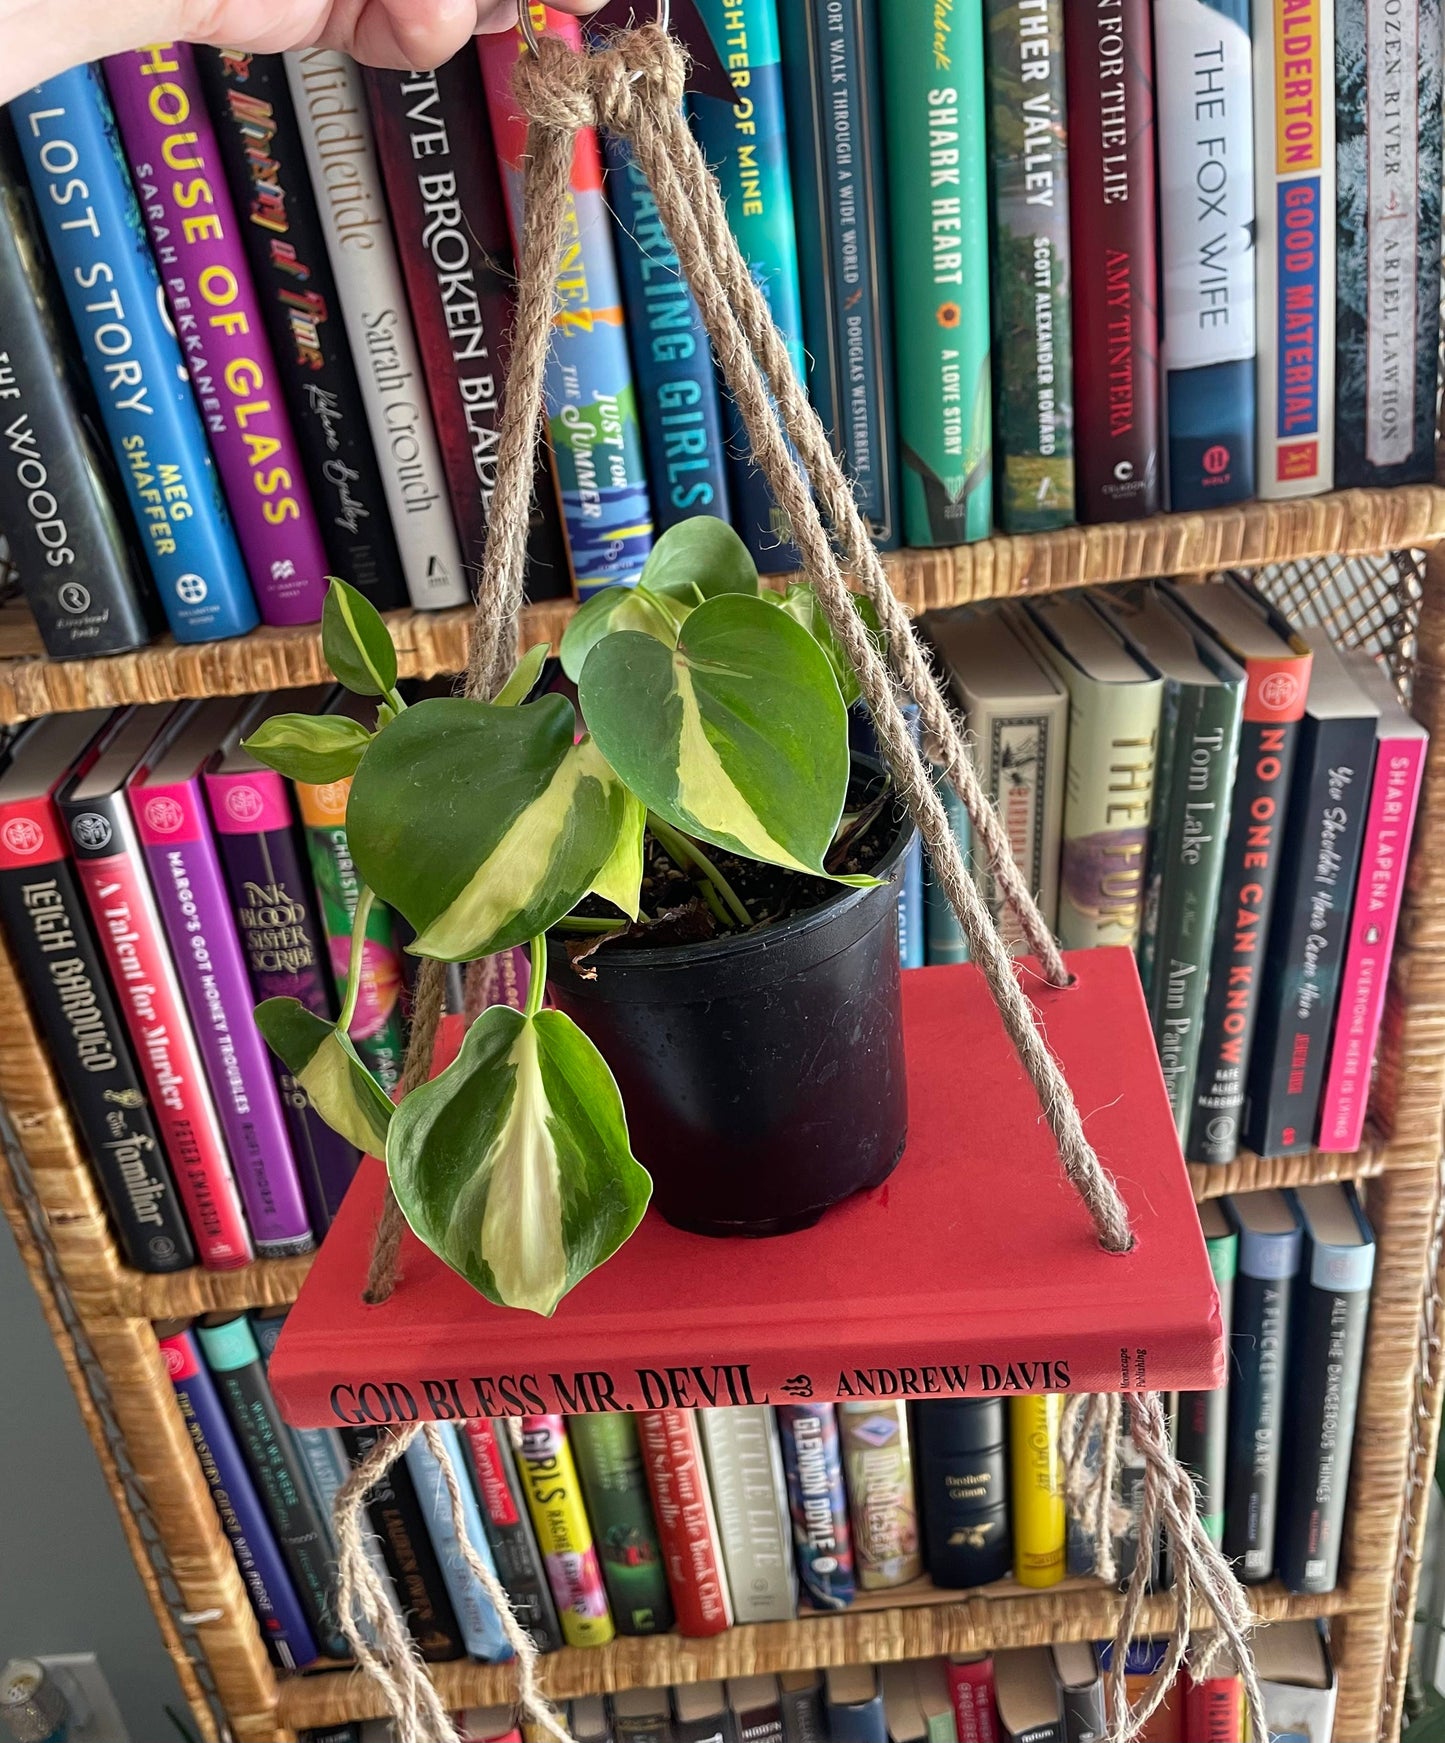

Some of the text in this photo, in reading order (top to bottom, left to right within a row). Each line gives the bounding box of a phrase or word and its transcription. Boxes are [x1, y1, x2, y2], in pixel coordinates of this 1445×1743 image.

[830, 38, 847, 84] WALK
[300, 47, 383, 250] Middletide
[733, 97, 756, 136] OF
[832, 88, 852, 165] THROUGH
[1023, 93, 1053, 208] VALLEY
[1098, 16, 1128, 205] FOR THE LIE
[1384, 91, 1400, 175] RIVER
[737, 144, 763, 217] MINE
[837, 170, 852, 181] A
[839, 184, 856, 226] WIDE
[927, 87, 963, 286] SHARK HEART
[1194, 40, 1229, 329] THE FOX WIFE
[29, 108, 153, 416] LOST STORY
[418, 170, 488, 362] BROKEN
[841, 231, 859, 284] WORLD
[1285, 186, 1314, 273] GOOD
[134, 43, 224, 244] HOUSE
[198, 265, 249, 336] OF
[224, 358, 300, 526] GLASS
[135, 163, 227, 434] SARAH PEKKANEN
[361, 309, 408, 393] Sarah
[562, 364, 582, 399] THE
[846, 316, 865, 383] DOUGLAS
[1034, 236, 1055, 456] SCOTT ALEXANDER HOWARD
[1105, 250, 1133, 437] AMY TINTERA
[1284, 283, 1314, 432] MATERIAL
[1382, 238, 1400, 441] ARIEL LAWHON
[592, 389, 628, 489] JUST FOR
[658, 379, 714, 509] GIRLS
[941, 349, 963, 456] A LOVE STORY
[5, 414, 75, 567] WOODS
[122, 434, 176, 556] SHAFFER
[158, 463, 193, 521] MEG
[383, 401, 441, 514] Crouch
[560, 404, 602, 519] SUMMER
[1106, 728, 1157, 824] THE
[1188, 726, 1224, 792] Tom
[1328, 766, 1354, 801] You
[1181, 802, 1215, 866] Lake
[1367, 756, 1410, 912] SHARI LAPENA
[1220, 729, 1286, 1064] NO ONE CAN KNOW
[22, 878, 117, 1073] LEIGH BARDUGO
[96, 879, 184, 1111] A Talent for Murder
[167, 851, 250, 1115] MARGO'S GOT MONEY TROUBLES
[1166, 958, 1197, 1010] Ann
[1351, 958, 1375, 1035] EVERYONE
[1344, 1039, 1360, 1075] HERE
[1333, 1097, 1353, 1140] LYING
[1327, 1328, 1346, 1358] THE
[1331, 1297, 1347, 1327] ALL
[330, 1364, 769, 1424] GOD BLESS MR. DEVIL
[835, 1360, 1072, 1397] ANDREW DAVIS
[1135, 1347, 1147, 1388] Publishing
[522, 1429, 566, 1505] GIRLS
[793, 1417, 836, 1550] GLENNON DOYLE
